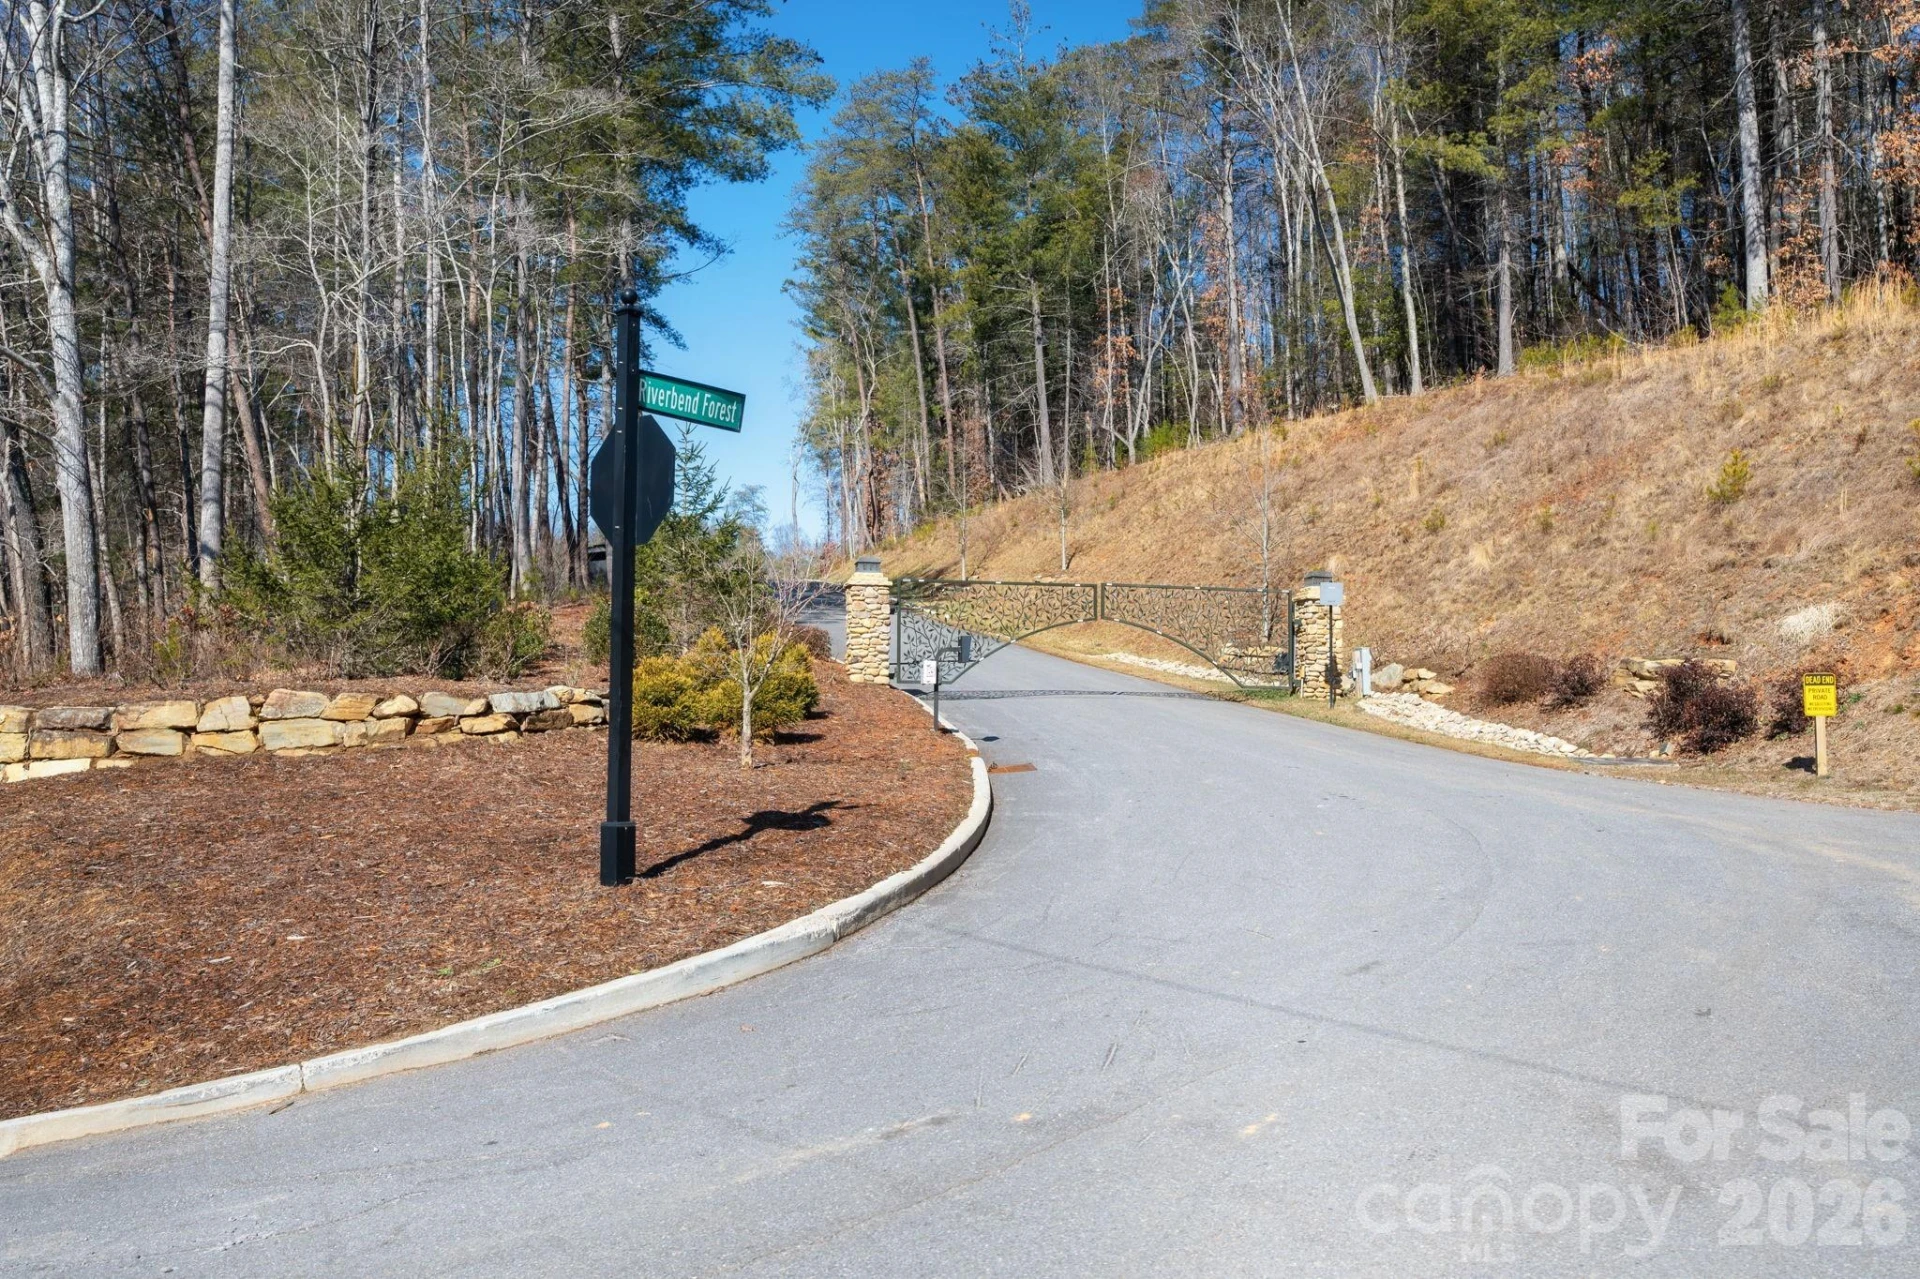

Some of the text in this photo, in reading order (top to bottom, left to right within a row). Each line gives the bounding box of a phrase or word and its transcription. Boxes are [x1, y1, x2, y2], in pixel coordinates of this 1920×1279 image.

[639, 379, 737, 423] Riverbend Forest
[1805, 675, 1834, 685] DEAD END
